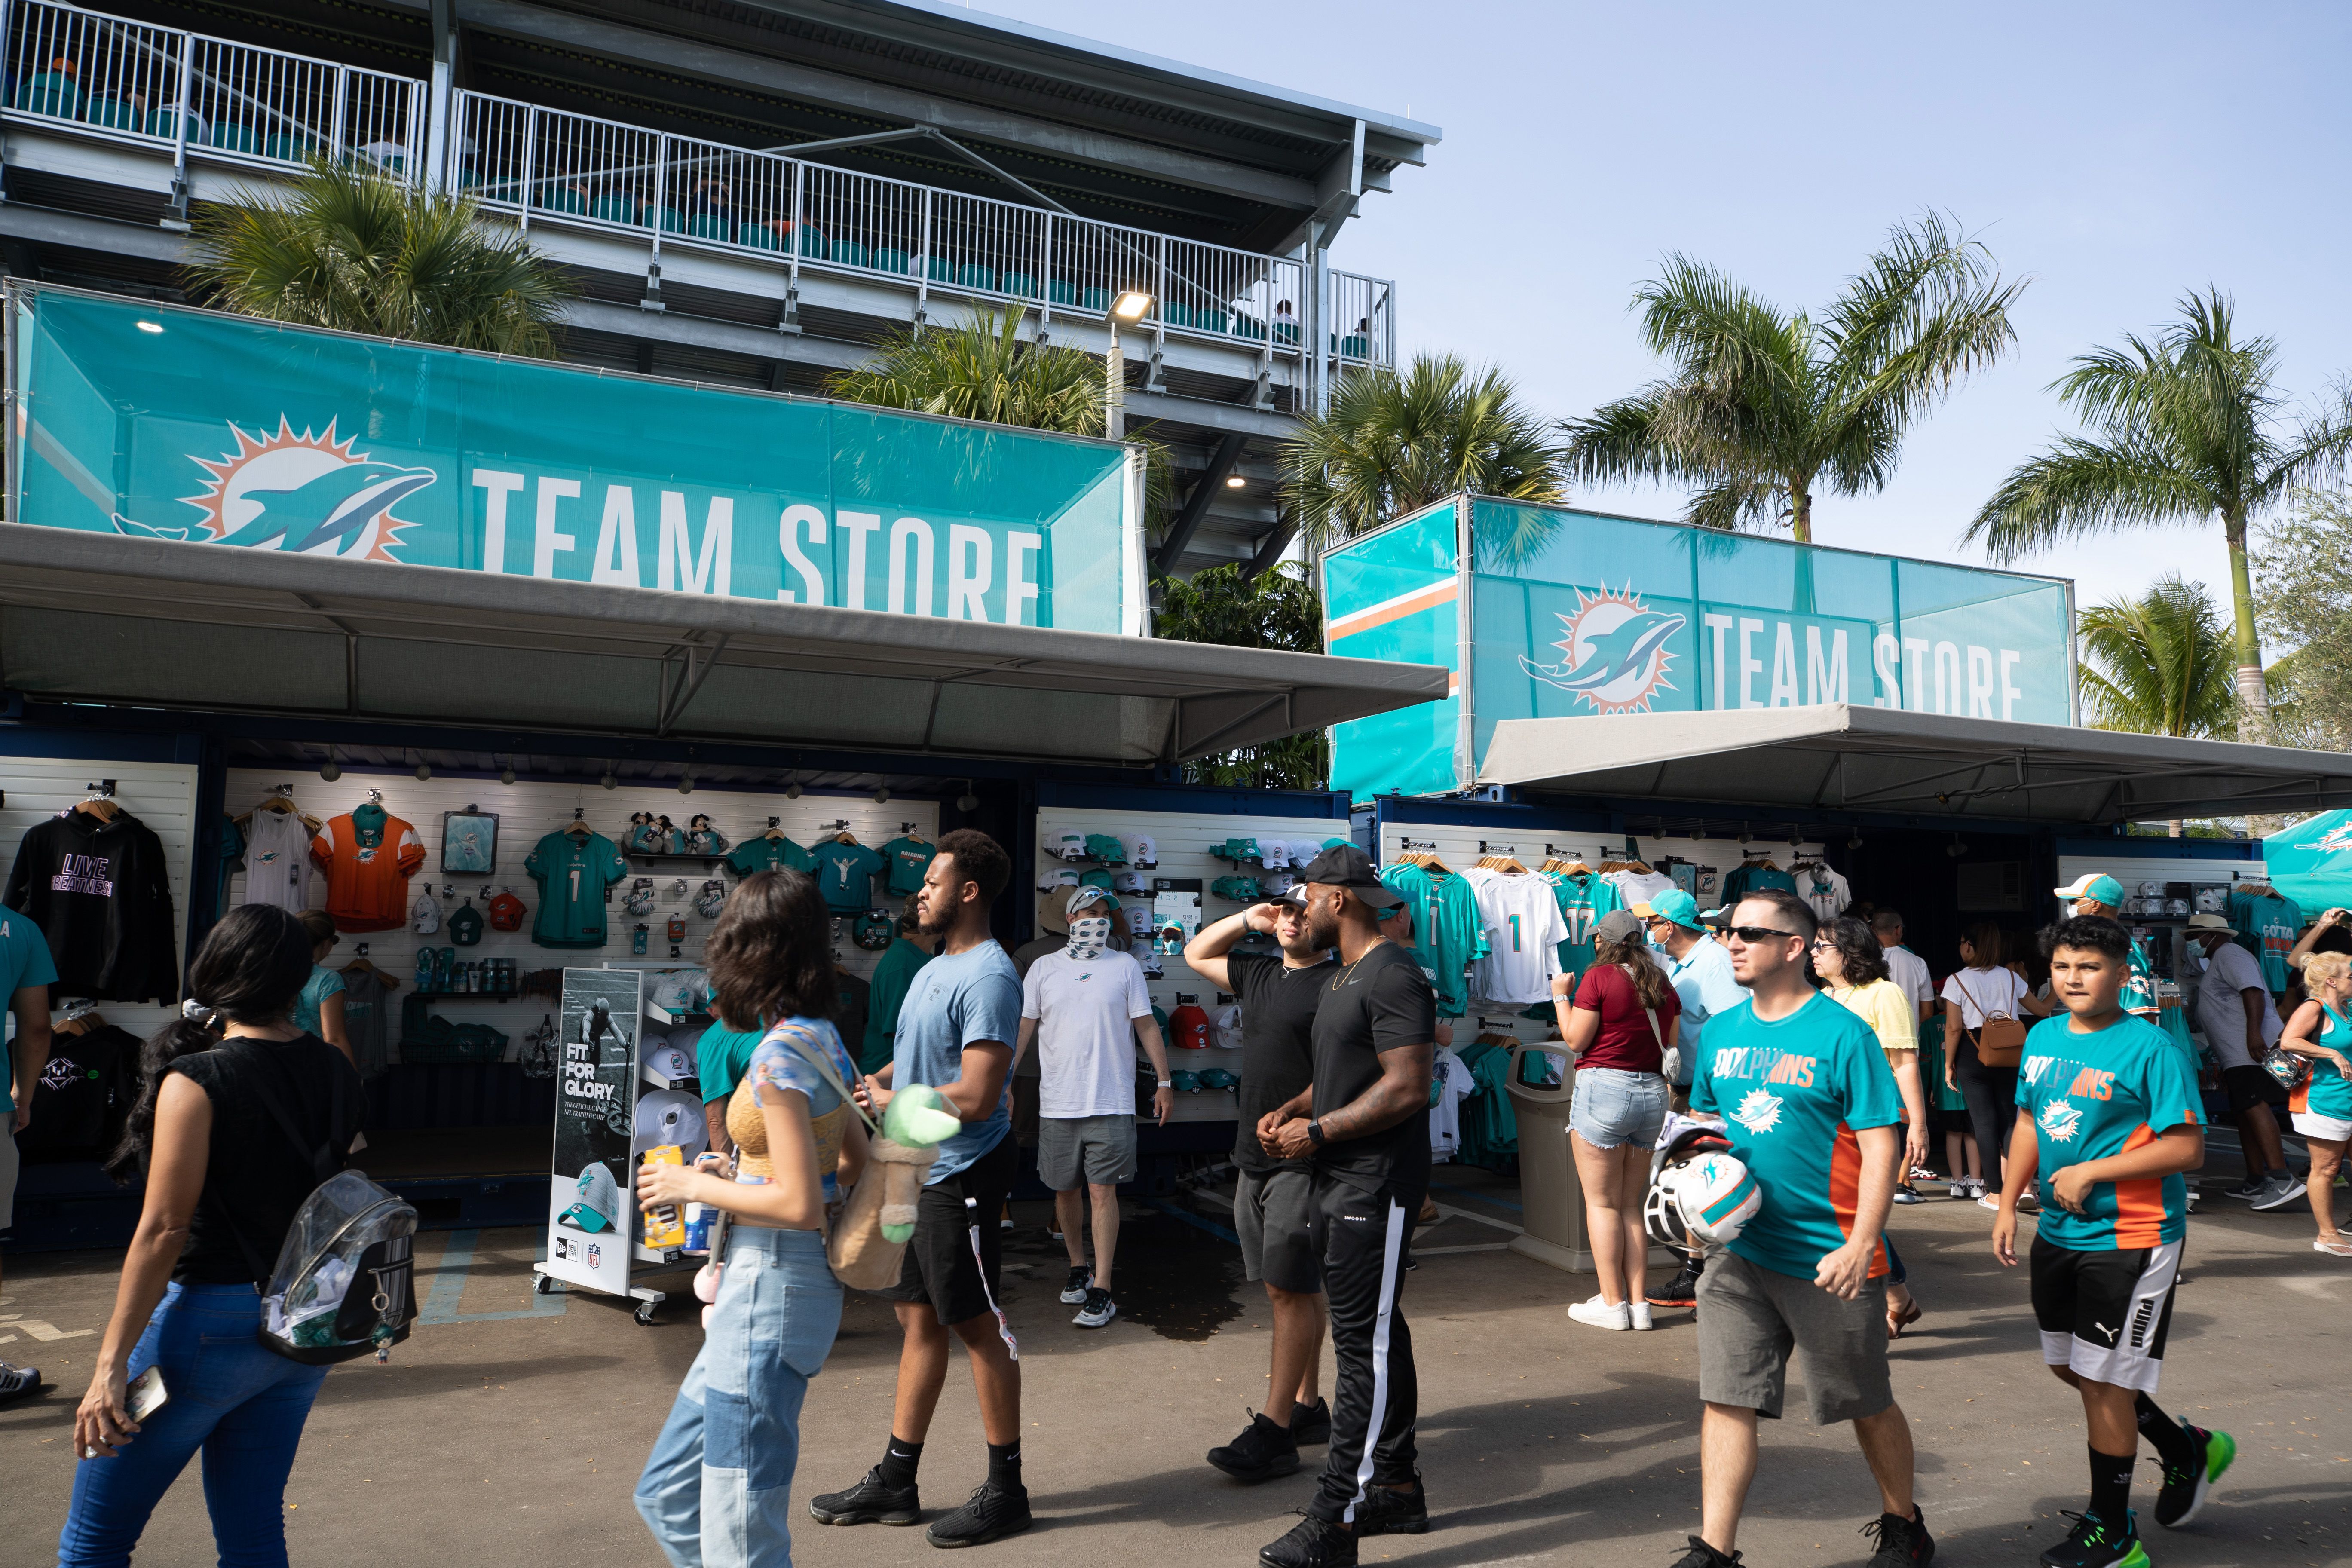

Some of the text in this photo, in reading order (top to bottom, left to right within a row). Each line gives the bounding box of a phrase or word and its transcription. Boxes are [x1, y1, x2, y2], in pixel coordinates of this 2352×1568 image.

[472, 469, 1043, 629] TEAM STORE
[1705, 613, 2021, 721] TEAM STORE
[61, 854, 109, 879] LIVE
[569, 870, 580, 903] 1
[1430, 906, 1439, 946] 1
[1508, 914, 1521, 953] 1
[1565, 907, 1595, 946] 17
[2262, 925, 2294, 940] GOTTA
[567, 1043, 588, 1060] FIT
[566, 1061, 595, 1080] FOR
[1713, 1046, 1816, 1088] DOLPHINS
[2024, 1055, 2116, 1101] DOLPHINS
[565, 1079, 615, 1101] GLORY
[573, 1102, 591, 1111] OFFICIAL
[573, 1110, 592, 1119] TRAINING
[589, 1254, 599, 1266] NFL
[998, 1311, 1007, 1325] NIKE
[2131, 1298, 2155, 1348] PUMA
